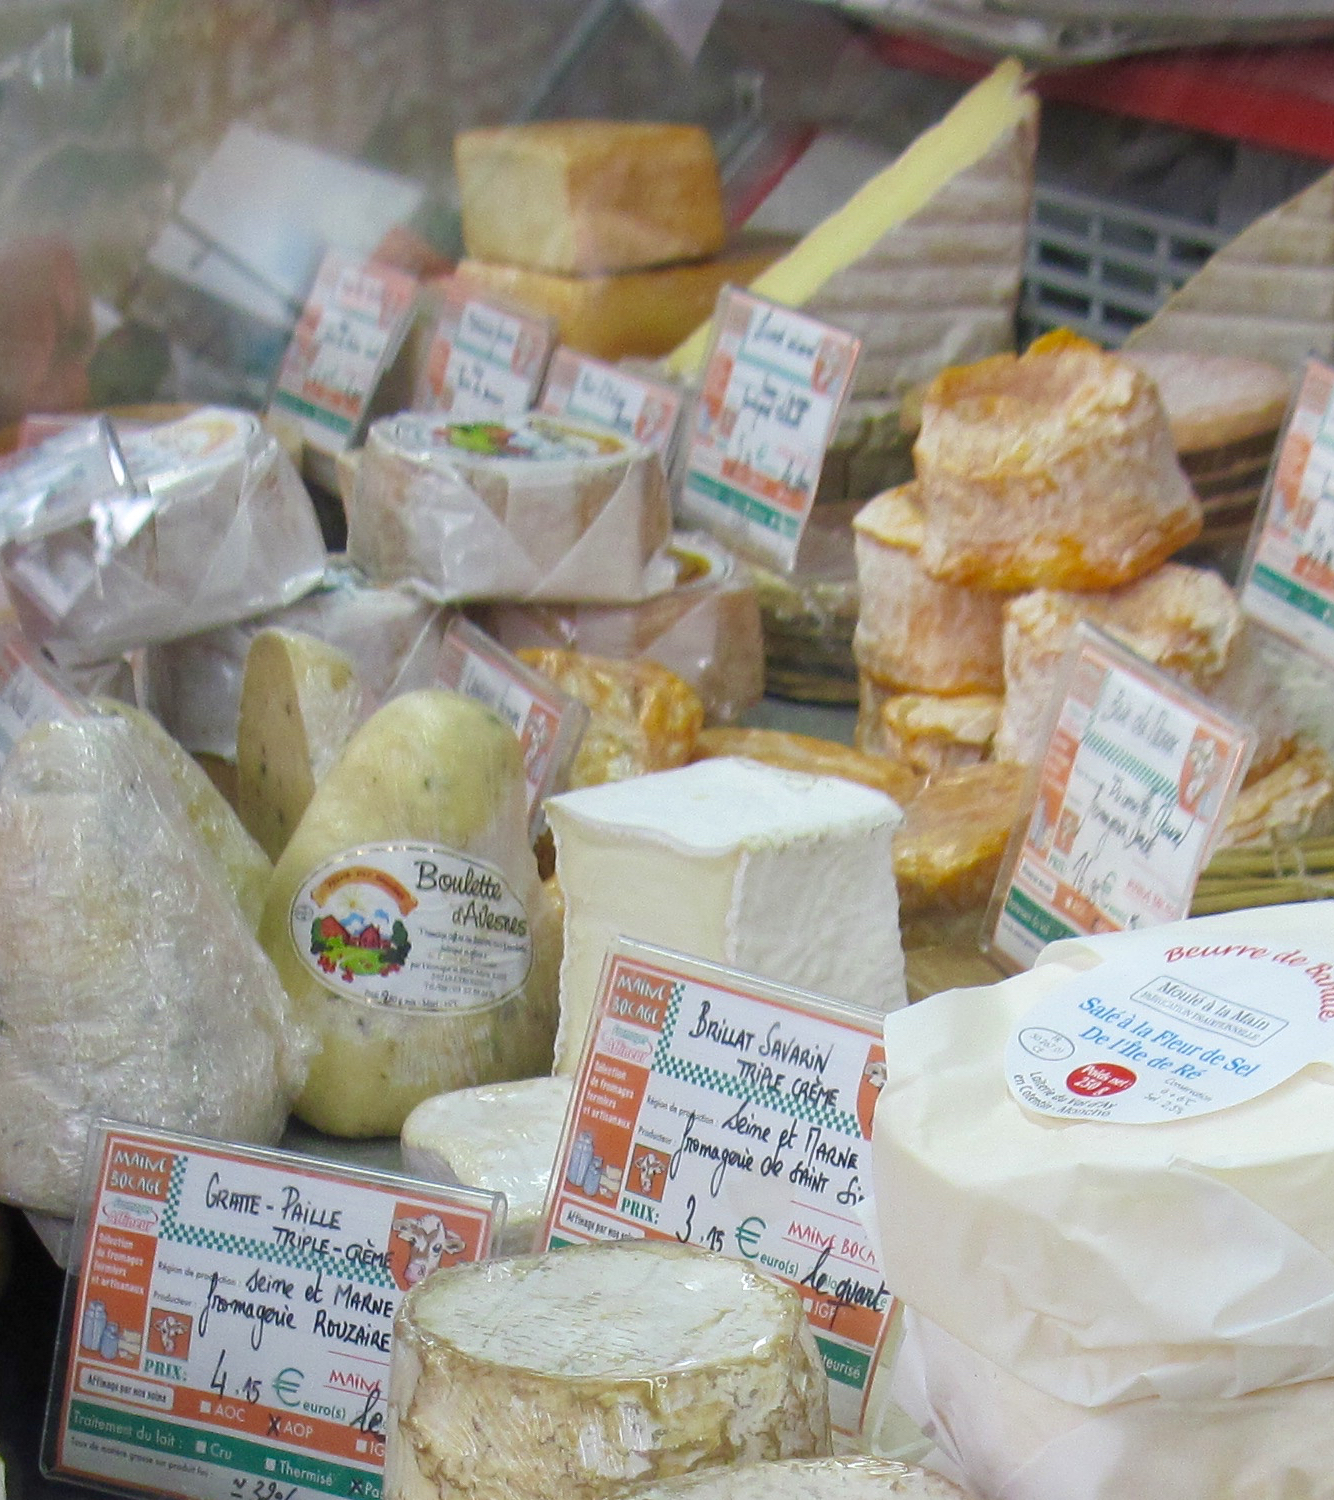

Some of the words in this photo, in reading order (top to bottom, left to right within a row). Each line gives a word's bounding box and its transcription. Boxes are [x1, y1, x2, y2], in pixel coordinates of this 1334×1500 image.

[414, 860, 503, 901] Boulette
[1164, 944, 1270, 963] Beurre
[1272, 949, 1309, 967] de
[1158, 981, 1204, 1007] Moulé
[1203, 999, 1217, 1012] à
[1217, 1003, 1230, 1018] la
[1229, 1008, 1271, 1032] Main
[1078, 996, 1121, 1024] Salé
[1117, 1013, 1134, 1030] à
[1132, 1019, 1152, 1038] la
[1151, 1029, 1203, 1060] Fleur
[1199, 1049, 1225, 1068] de
[1223, 1056, 1262, 1079] Sel
[1079, 1025, 1111, 1046] De
[1146, 1056, 1174, 1073] de
[1173, 1063, 1209, 1080] Ré
[737, 1058, 786, 1094] TRIPLE
[791, 1075, 840, 1108] CRÈME
[1073, 1076, 1096, 1091] 250
[1080, 1064, 1113, 1082] Poids
[1055, 1105, 1112, 1118] Manche
[115, 1150, 167, 1173] MAINE
[110, 1172, 163, 1196] BOCAGE
[157, 1261, 182, 1276] Région
[184, 1264, 195, 1277] de
[758, 1254, 799, 1277] euro(s)
[87, 1373, 118, 1393] Affinage
[119, 1383, 131, 1395] par
[214, 1403, 246, 1423] AOC
[283, 1423, 314, 1440] AOP
[302, 1401, 347, 1421] euro(s)
[72, 1410, 133, 1436] Traitement
[136, 1425, 153, 1442] du
[156, 1429, 176, 1448] lait
[210, 1443, 233, 1461] Cru
[280, 1459, 334, 1487] Thermisé
